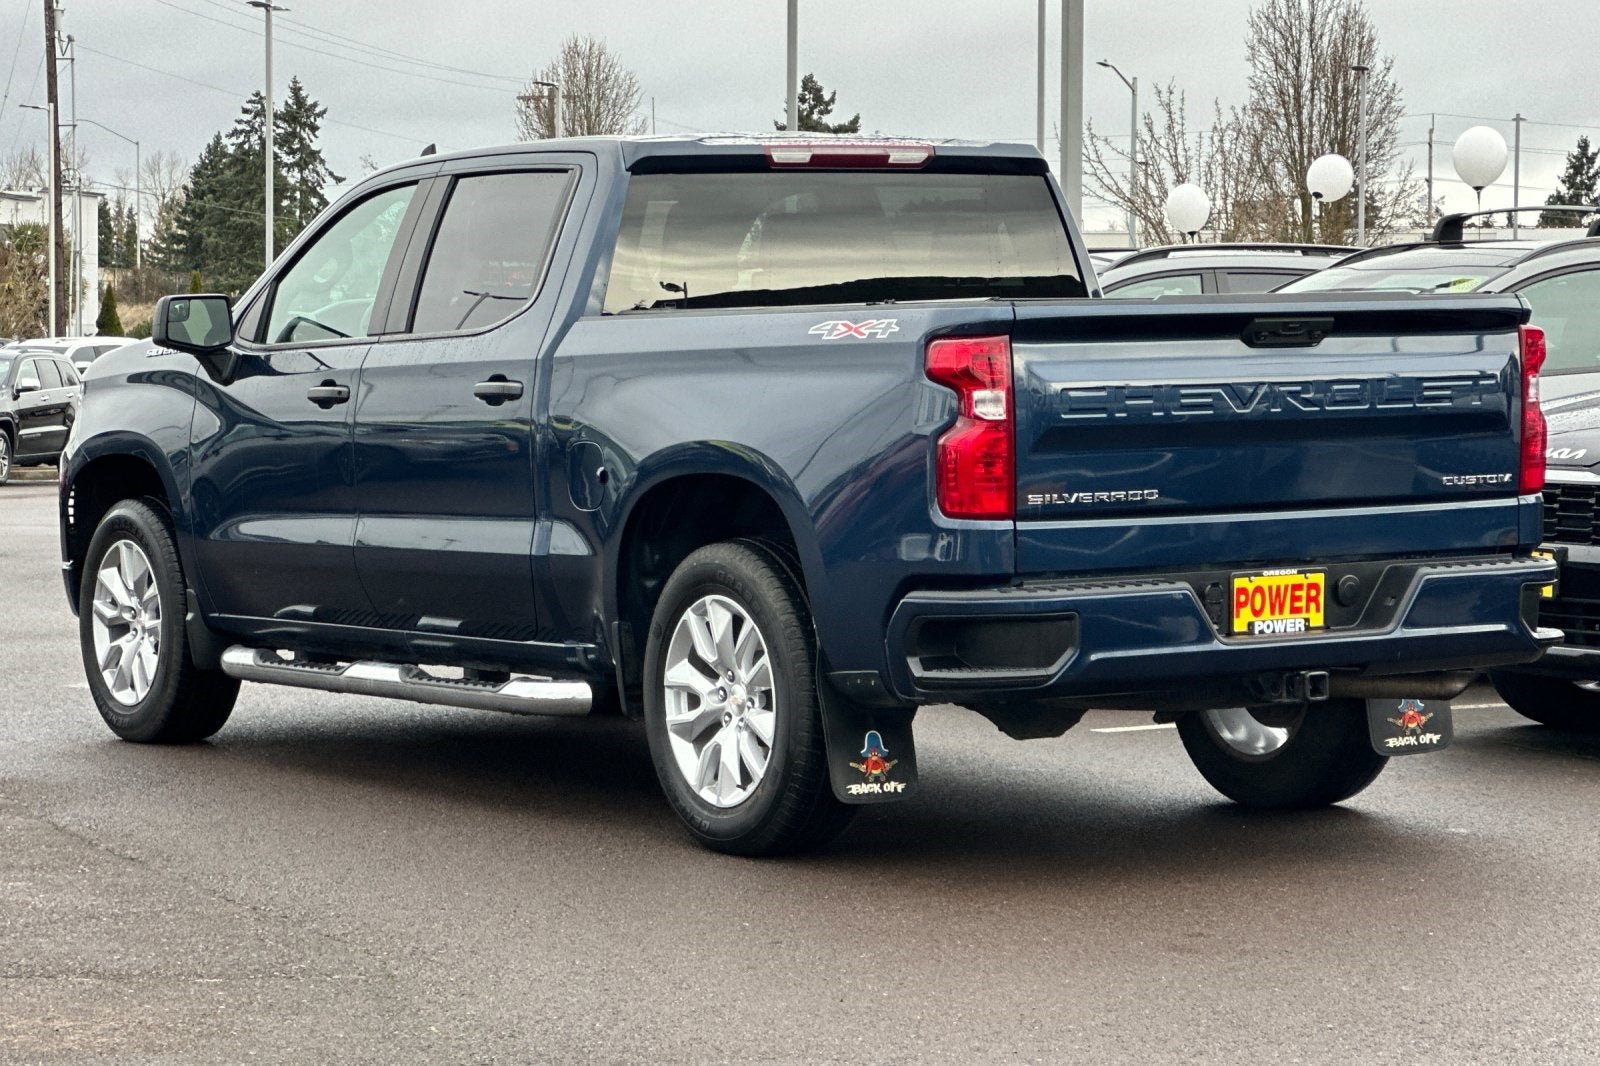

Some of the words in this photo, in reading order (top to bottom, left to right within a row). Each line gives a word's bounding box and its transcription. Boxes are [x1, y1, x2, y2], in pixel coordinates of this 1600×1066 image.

[808, 318, 900, 340] 4X4
[1060, 375, 1498, 418] CHEVROLET
[1442, 473, 1513, 486] CUSTOM
[1027, 489, 1159, 506] SILVERADO
[1262, 568, 1298, 577] OREGON
[1234, 582, 1322, 619] POWER
[1253, 618, 1306, 635] POWER
[1384, 735, 1418, 748] BACK
[1420, 733, 1442, 744] OFF
[846, 782, 882, 795] BACK
[883, 780, 907, 793] OFF
